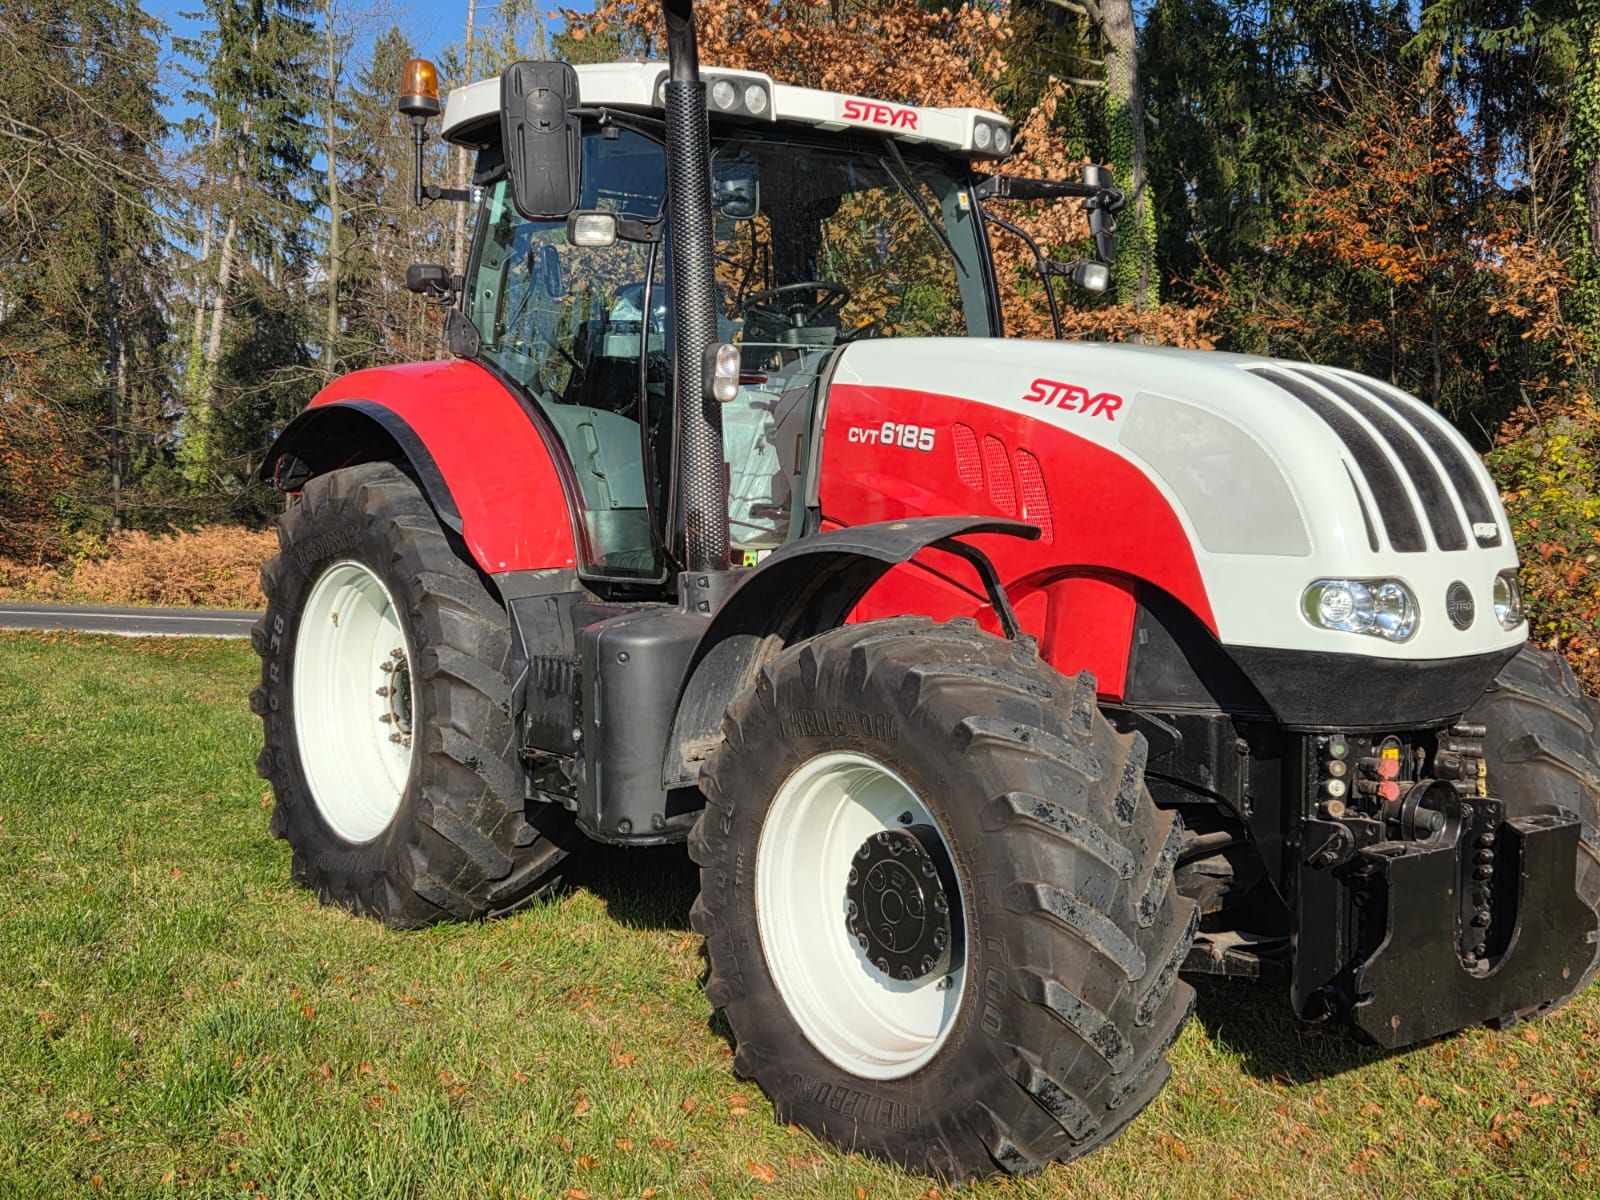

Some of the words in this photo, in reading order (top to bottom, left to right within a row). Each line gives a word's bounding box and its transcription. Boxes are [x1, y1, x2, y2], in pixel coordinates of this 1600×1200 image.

[841, 100, 918, 130] STEYR
[1022, 378, 1123, 421] STEYR
[848, 426, 879, 445] CVT
[880, 421, 936, 451] 6185
